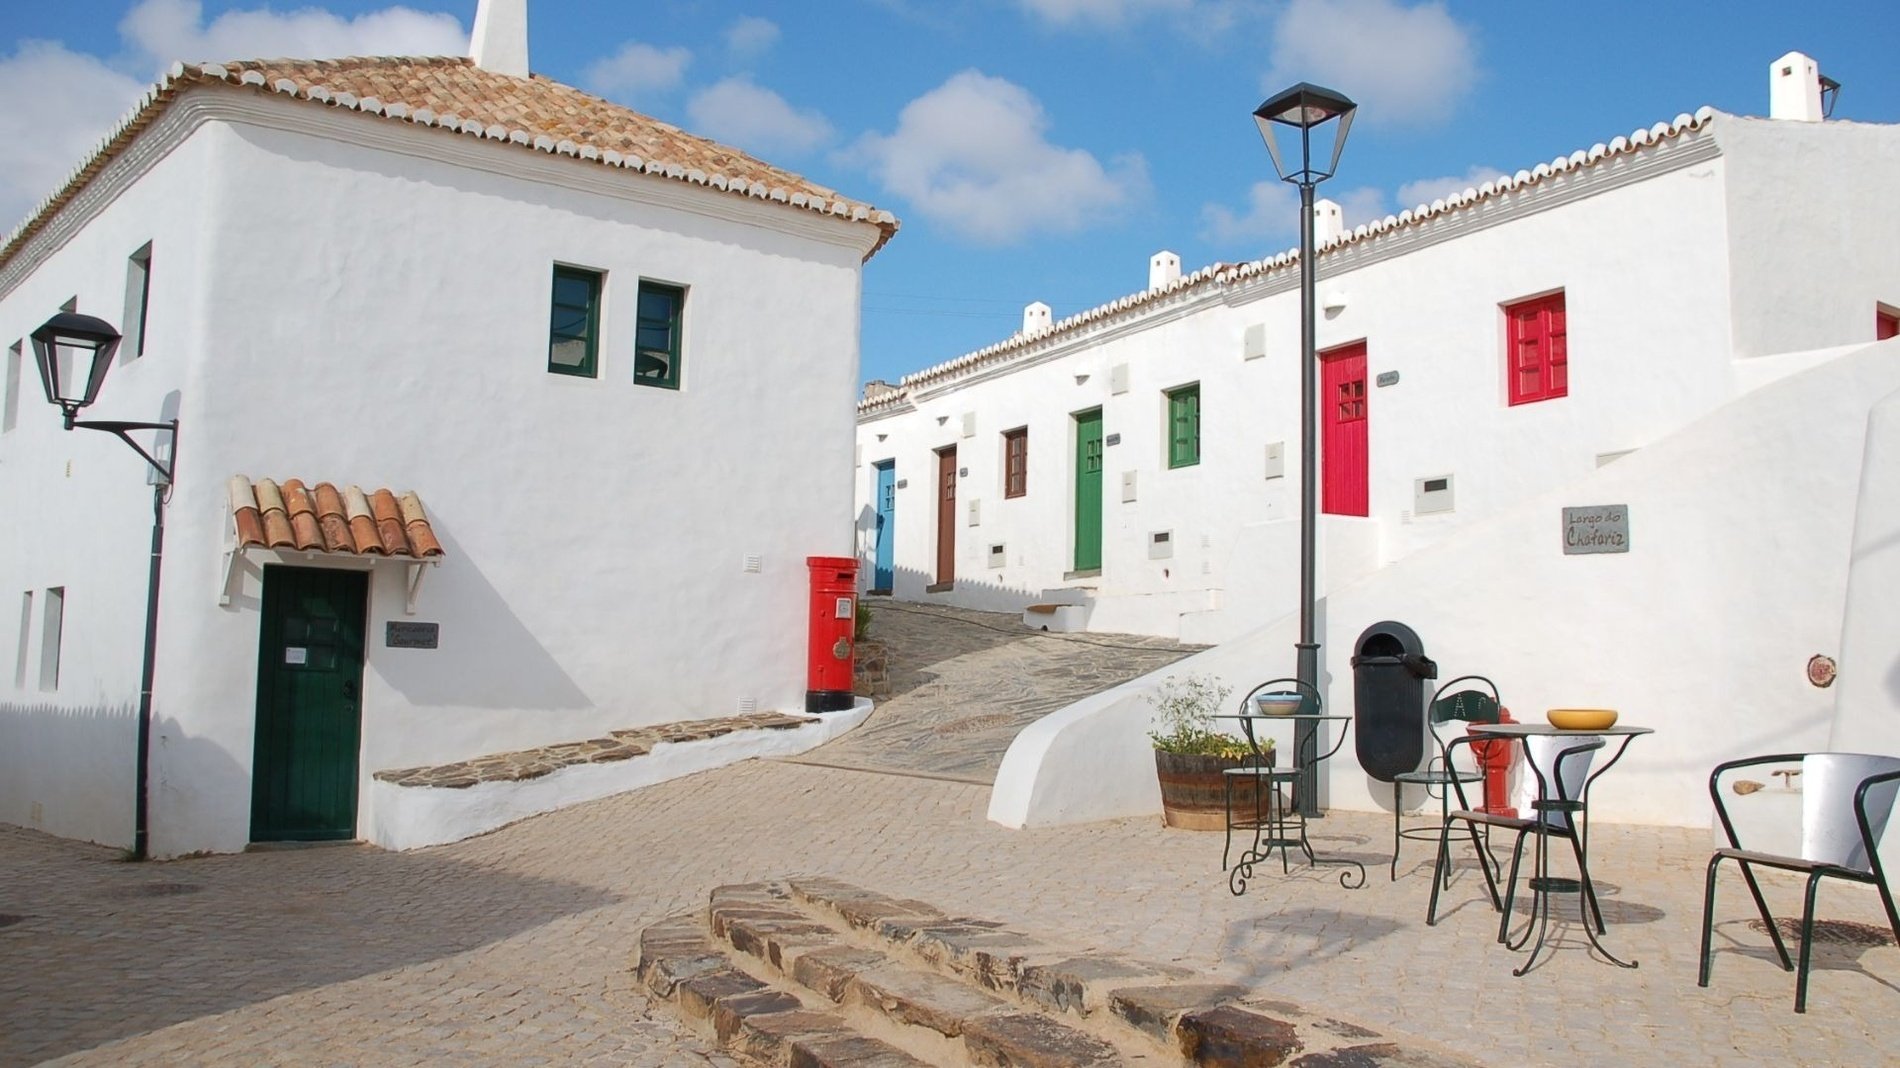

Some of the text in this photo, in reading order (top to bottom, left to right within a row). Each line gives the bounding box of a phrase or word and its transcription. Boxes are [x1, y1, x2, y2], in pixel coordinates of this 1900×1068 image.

[1569, 511, 1620, 528] Largo do
[1567, 526, 1624, 546] Chafariz
